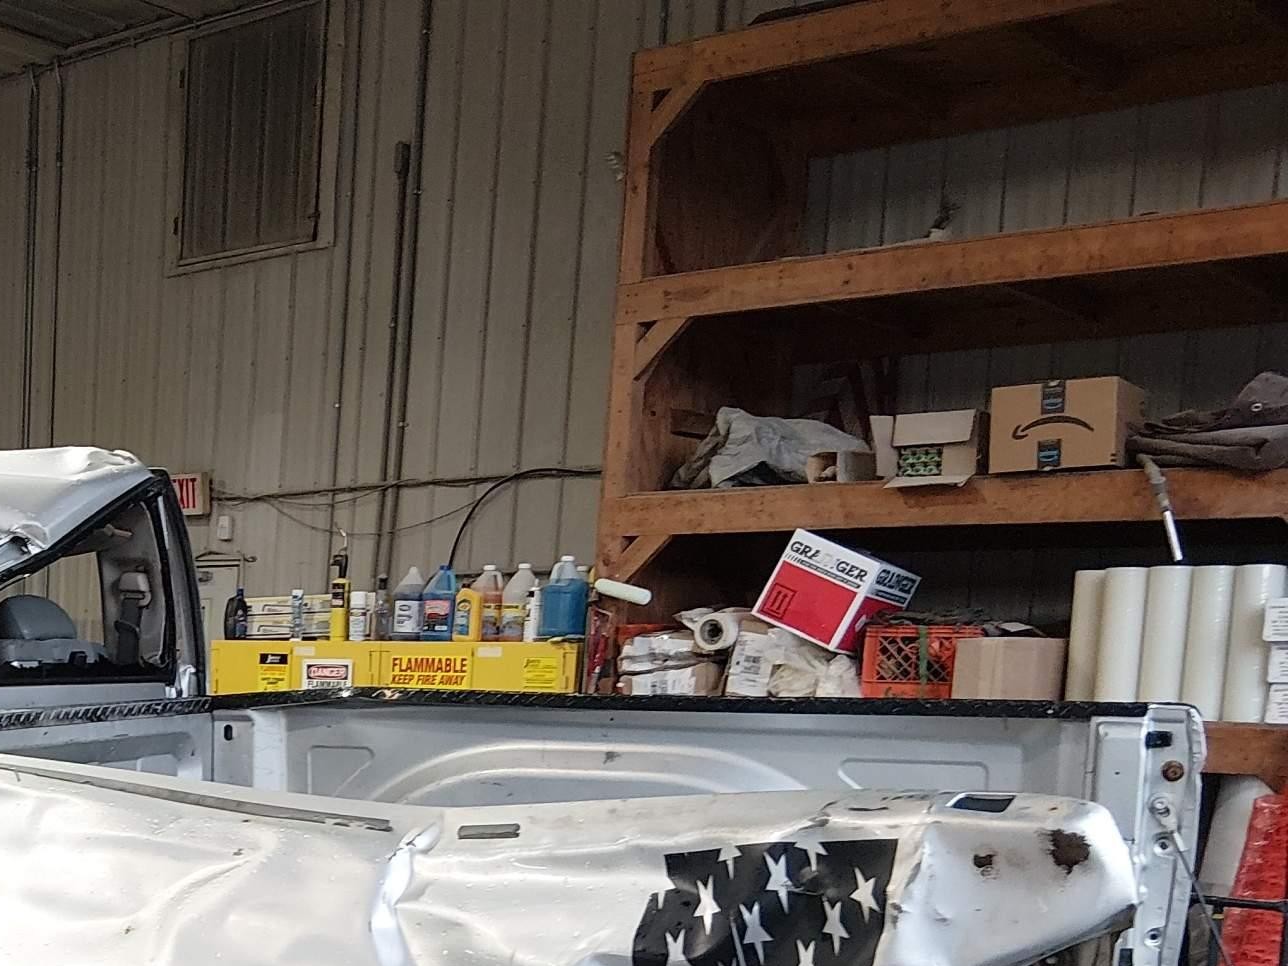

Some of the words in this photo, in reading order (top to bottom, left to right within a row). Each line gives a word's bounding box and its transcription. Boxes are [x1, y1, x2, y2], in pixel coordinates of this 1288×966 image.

[172, 478, 197, 508] XIT
[790, 541, 868, 582] GRAGER
[392, 657, 468, 673] FLAMMABLE
[392, 674, 415, 684] KEEP
[416, 675, 437, 685] FIRE
[438, 675, 465, 685] AWAY
